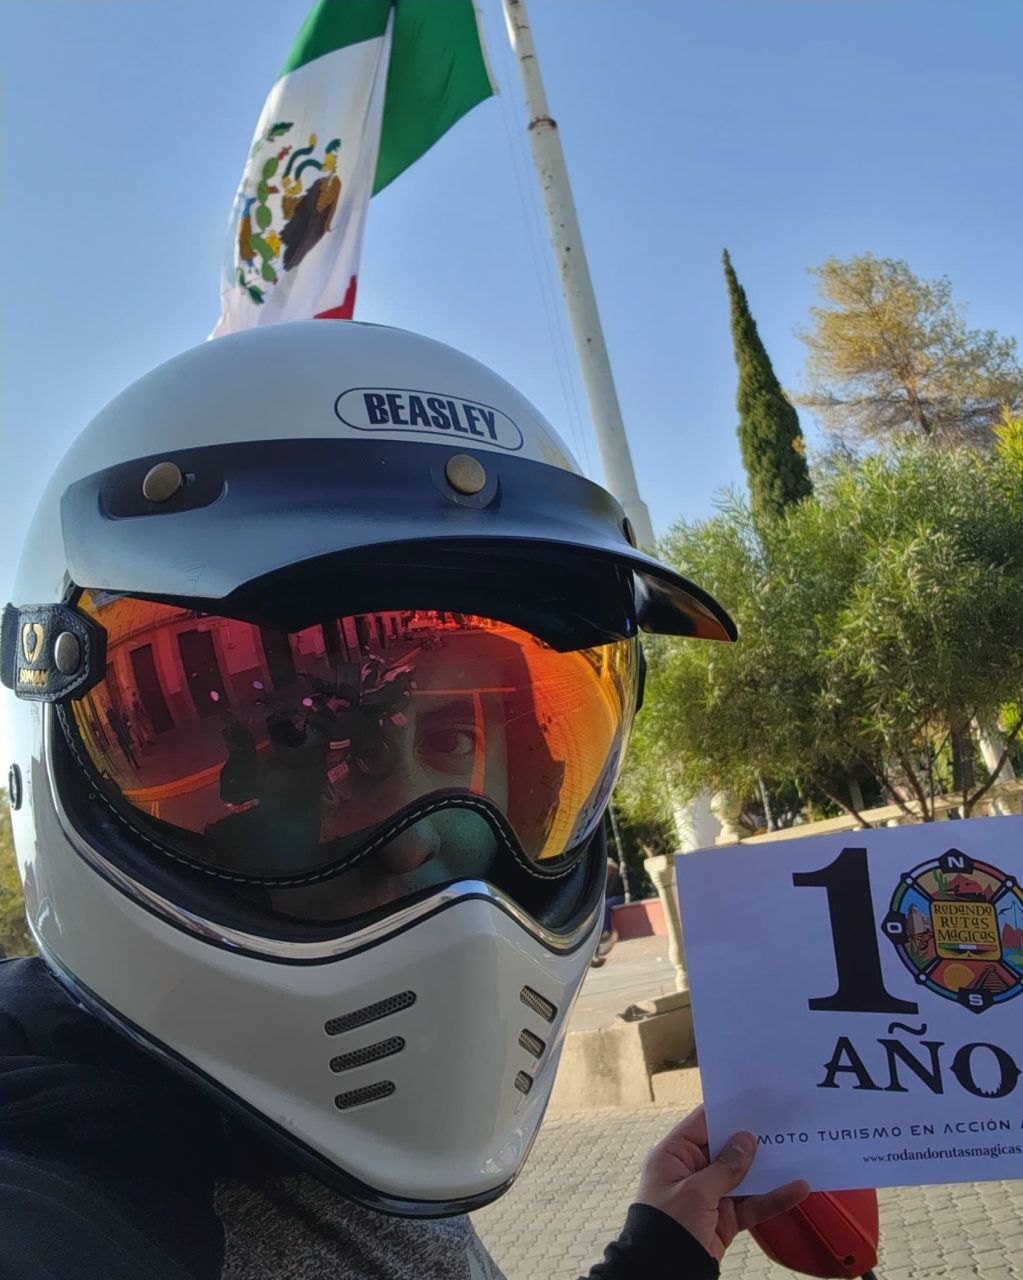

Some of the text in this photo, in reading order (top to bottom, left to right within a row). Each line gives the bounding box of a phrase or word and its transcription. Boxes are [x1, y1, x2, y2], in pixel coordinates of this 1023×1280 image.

[363, 393, 498, 441] BEASLEY
[947, 856, 965, 868] N
[792, 847, 919, 1015] 1
[886, 922, 903, 933] O
[968, 994, 984, 1006] S
[816, 1022, 1022, 1099] AÑO
[757, 1132, 809, 1145] MOTO
[817, 1126, 903, 1142] TURISMO
[910, 1124, 935, 1136] EN
[943, 1118, 1011, 1135] ACCIÓN
